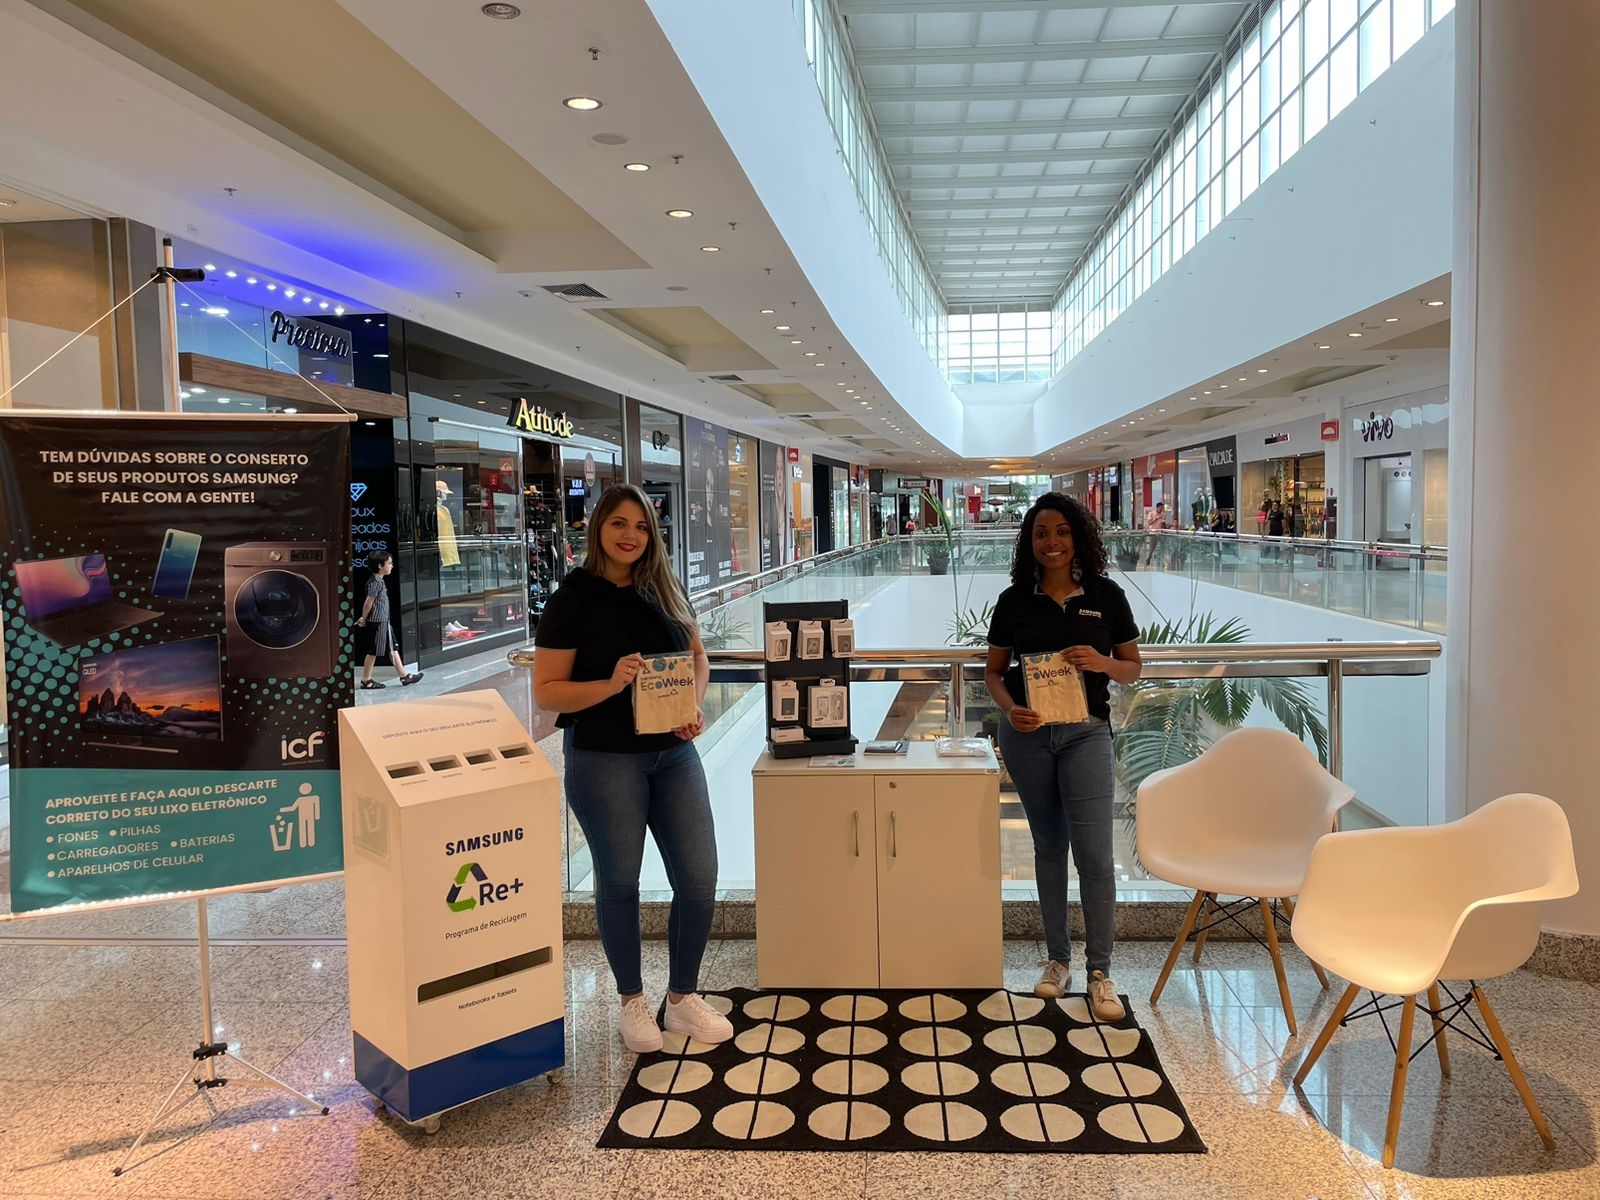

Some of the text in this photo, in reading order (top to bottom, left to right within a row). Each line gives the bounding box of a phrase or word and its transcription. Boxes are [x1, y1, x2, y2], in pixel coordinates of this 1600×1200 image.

[508, 397, 576, 438] Atitude
[1361, 412, 1393, 443] vivo
[40, 448, 308, 465] TEM DÚVIDAS SOBRE O CONSERTO
[53, 471, 298, 485] DE SEUS PRODUTOS SAMSUNG?
[102, 491, 255, 504] FALE COM A GENTE!
[351, 522, 390, 533] eados
[640, 677, 693, 691] EcoWeek
[1026, 666, 1072, 680] coWeek
[46, 779, 278, 809] APROVEITE E FAÇA AQUI O DESCARTE
[46, 794, 267, 825] CORRETO DO SEU LIXO ELETRÔNICO
[56, 833, 235, 861] CARREGADORES BATERIAS
[58, 824, 161, 844] FONES PILHAS
[445, 826, 524, 857] SAMSUNG
[58, 853, 204, 879] APARELHOS DE CELULAR
[479, 878, 524, 907] Re+
[445, 912, 527, 940] Programa de Reciclagem
[458, 996, 490, 1010] Notebooks
[497, 988, 517, 998] Tablets
